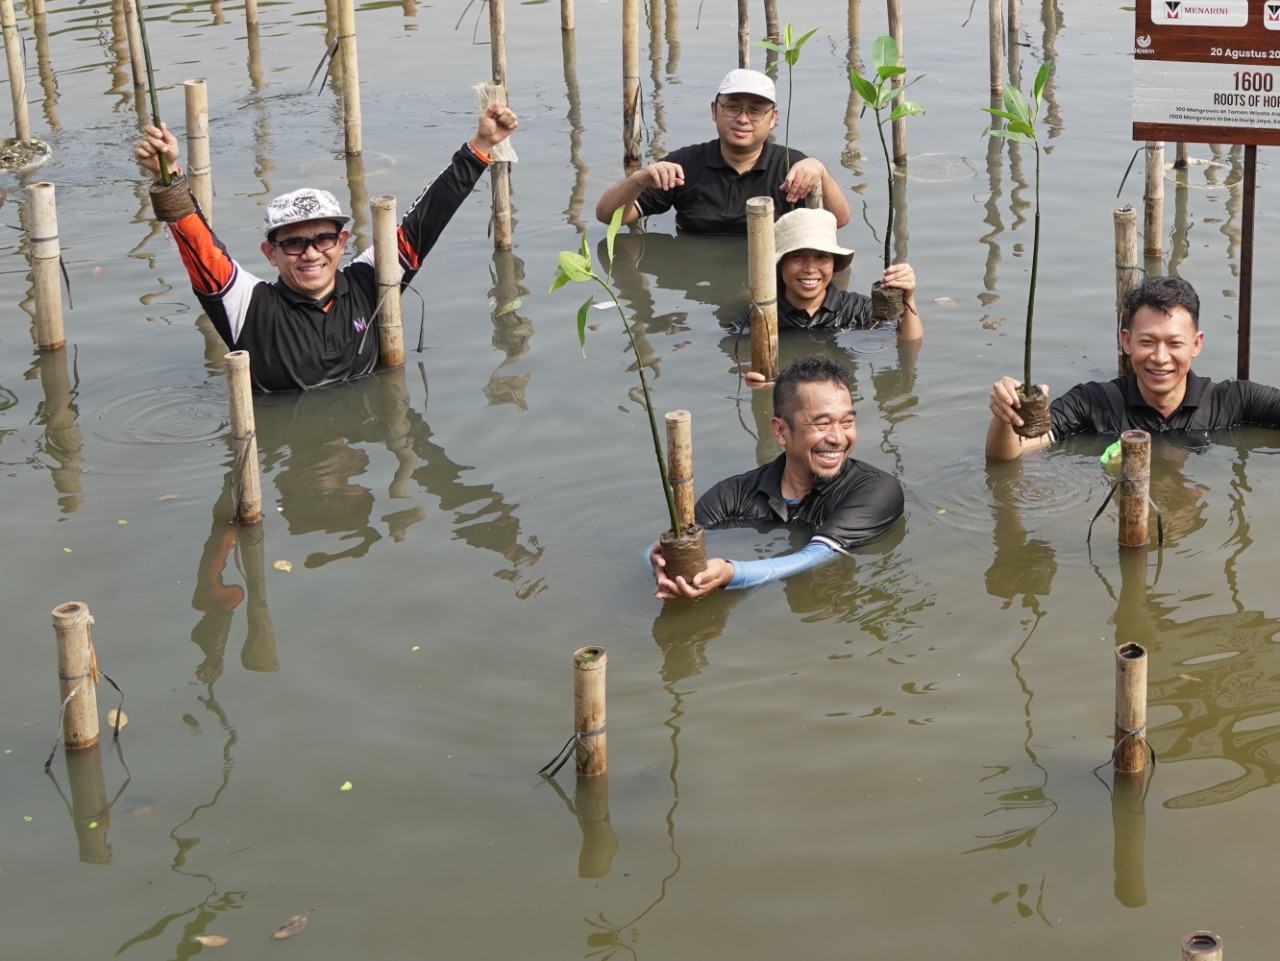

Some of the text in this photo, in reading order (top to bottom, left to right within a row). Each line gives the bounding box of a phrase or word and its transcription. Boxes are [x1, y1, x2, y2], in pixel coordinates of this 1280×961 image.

[1184, 7, 1228, 15] MENARINI
[1210, 47, 1223, 56] 20
[1224, 48, 1267, 60] Agustus
[1233, 71, 1274, 92] 1600
[1214, 93, 1246, 107] ROOTS
[1248, 94, 1261, 107] OF
